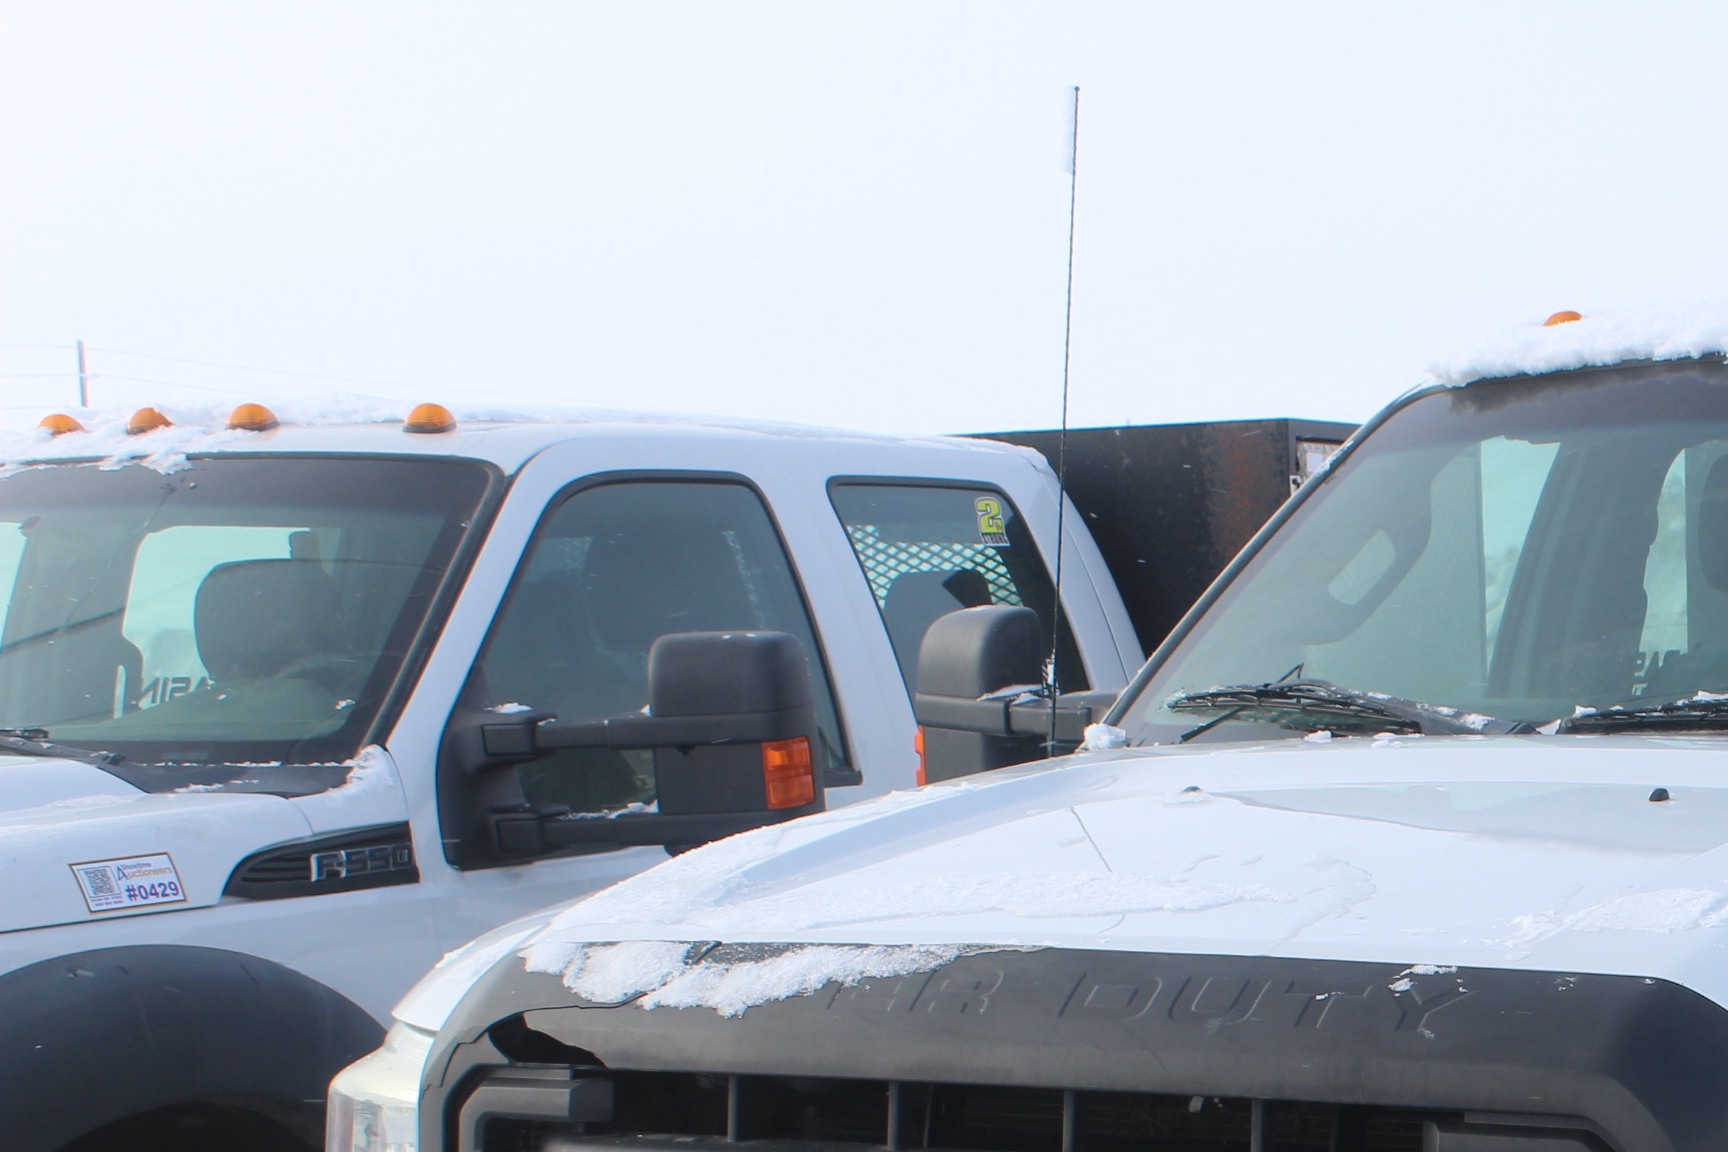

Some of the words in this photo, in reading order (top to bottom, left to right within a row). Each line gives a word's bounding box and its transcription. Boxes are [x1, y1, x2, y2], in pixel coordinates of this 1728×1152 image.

[310, 843, 412, 882] F-550
[125, 881, 180, 902] #0429
[1057, 970, 1481, 1034] DUTY
